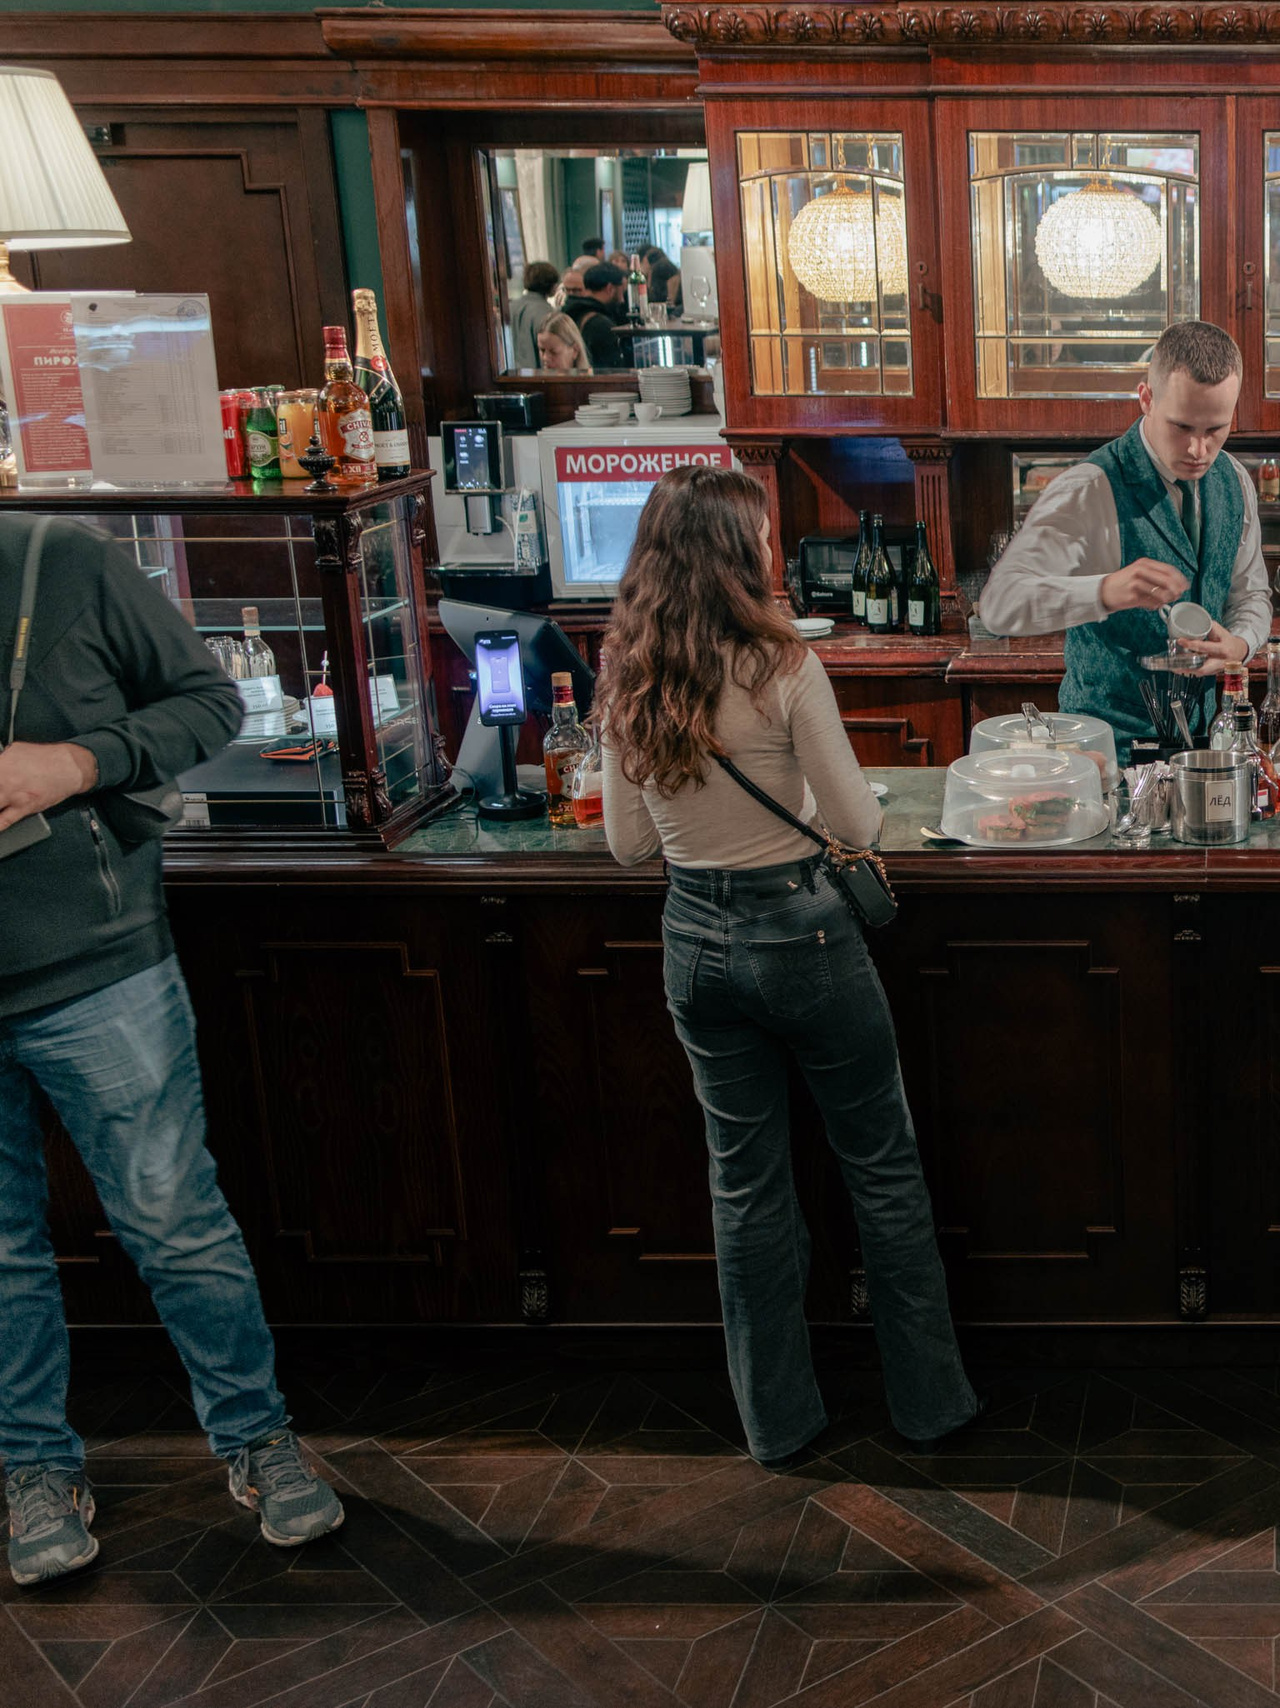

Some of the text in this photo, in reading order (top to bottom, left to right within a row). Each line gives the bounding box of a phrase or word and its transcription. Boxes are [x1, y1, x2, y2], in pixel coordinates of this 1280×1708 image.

[34, 356, 79, 366] ПИРОЖ
[566, 453, 722, 474] МОРОЖЕНОЕ
[1209, 793, 1231, 807] ЛЁД
